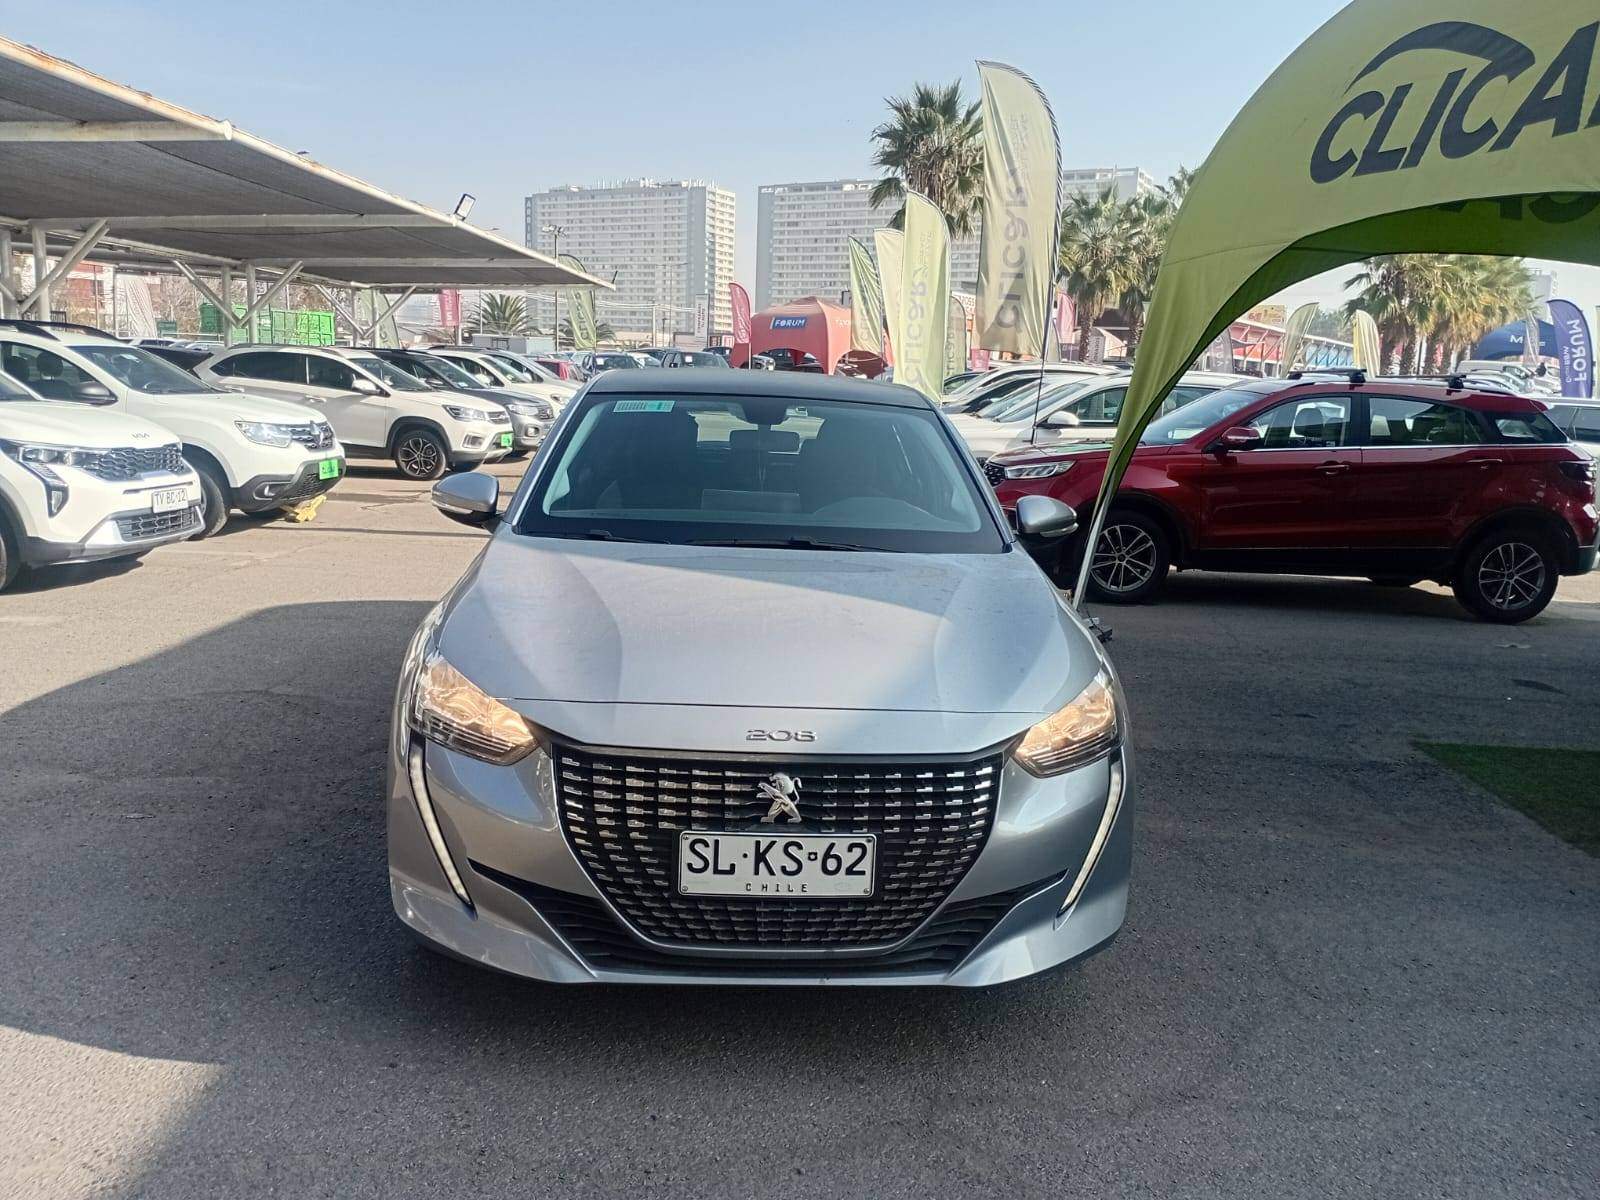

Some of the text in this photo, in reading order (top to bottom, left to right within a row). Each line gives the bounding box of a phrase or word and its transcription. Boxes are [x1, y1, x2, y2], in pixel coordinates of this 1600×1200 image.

[1310, 20, 1600, 184] CLICA
[774, 319, 805, 328] FORUM
[745, 883, 809, 893] CHILE
